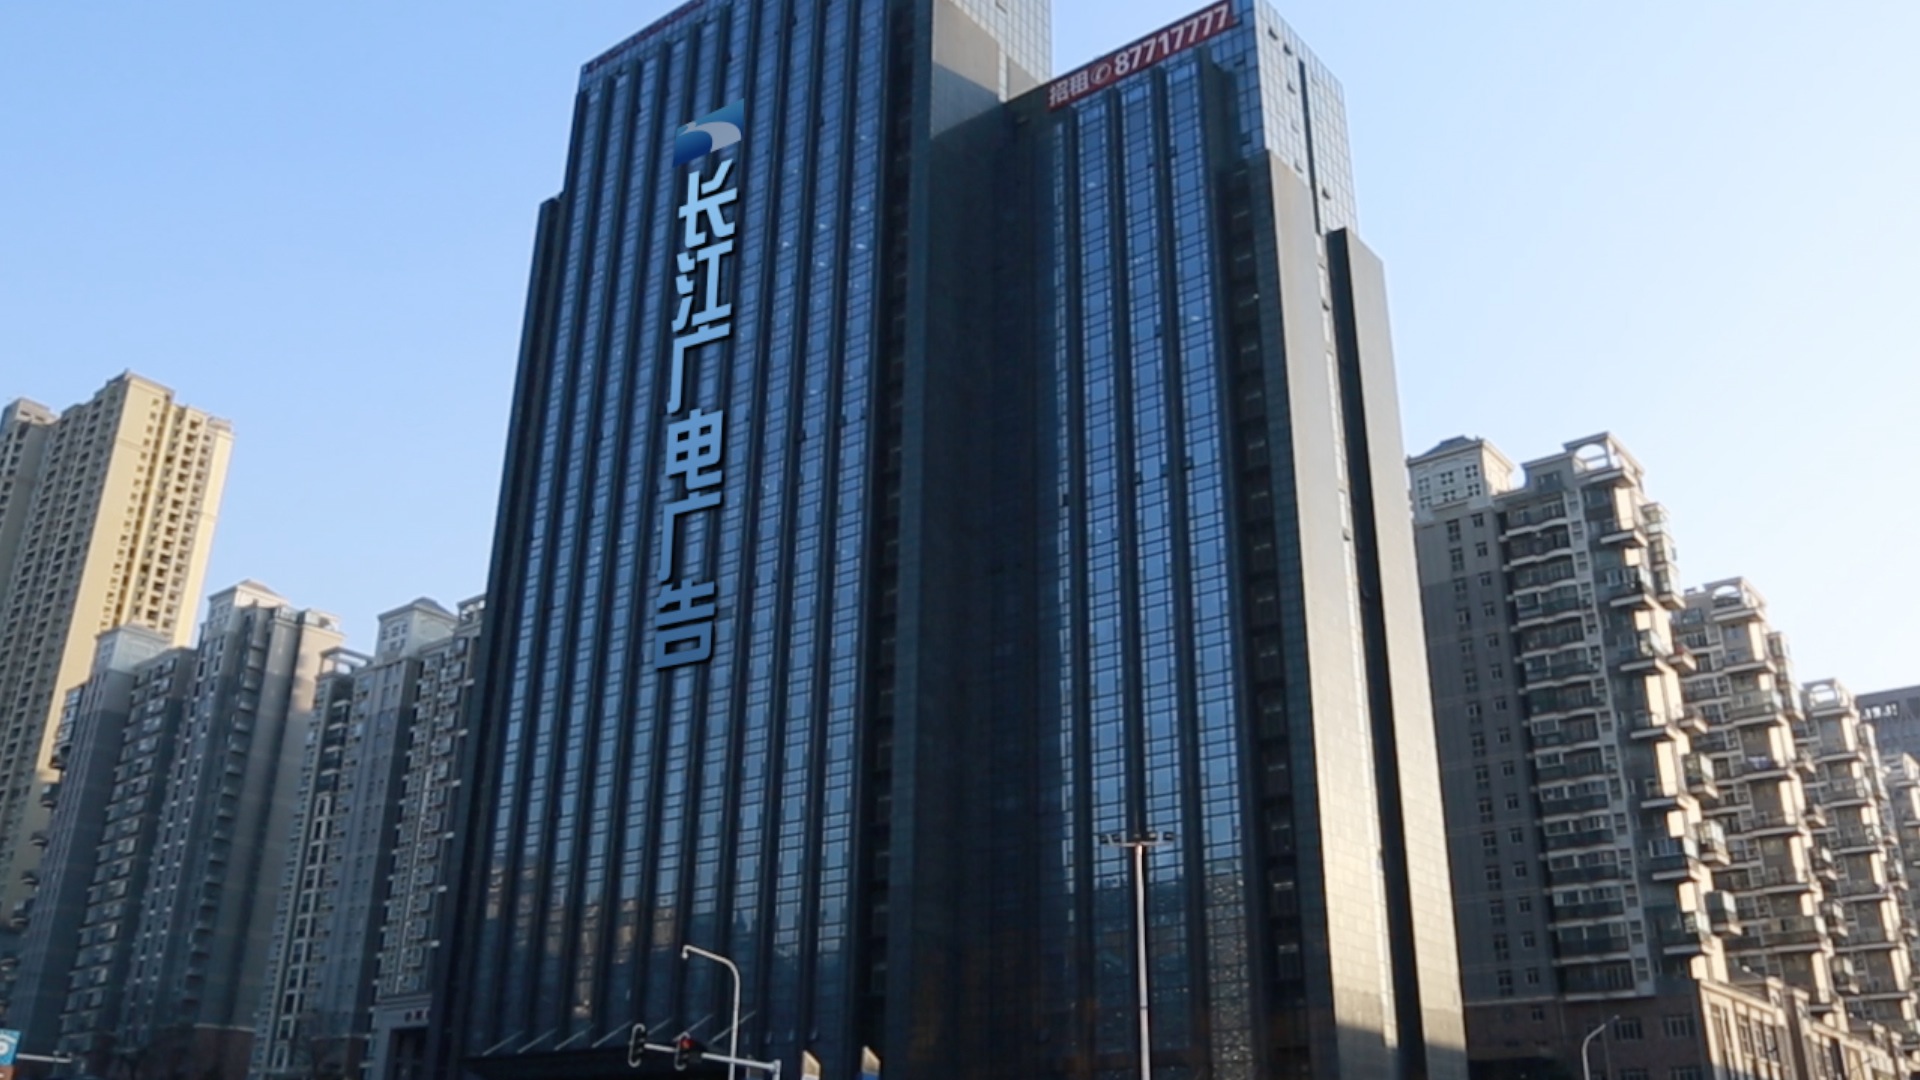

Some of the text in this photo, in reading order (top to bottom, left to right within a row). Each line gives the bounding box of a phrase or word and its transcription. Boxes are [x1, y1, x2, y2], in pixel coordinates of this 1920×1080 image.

[1114, 4, 1229, 76] 87717777
[654, 160, 738, 670] 长江广电广告
